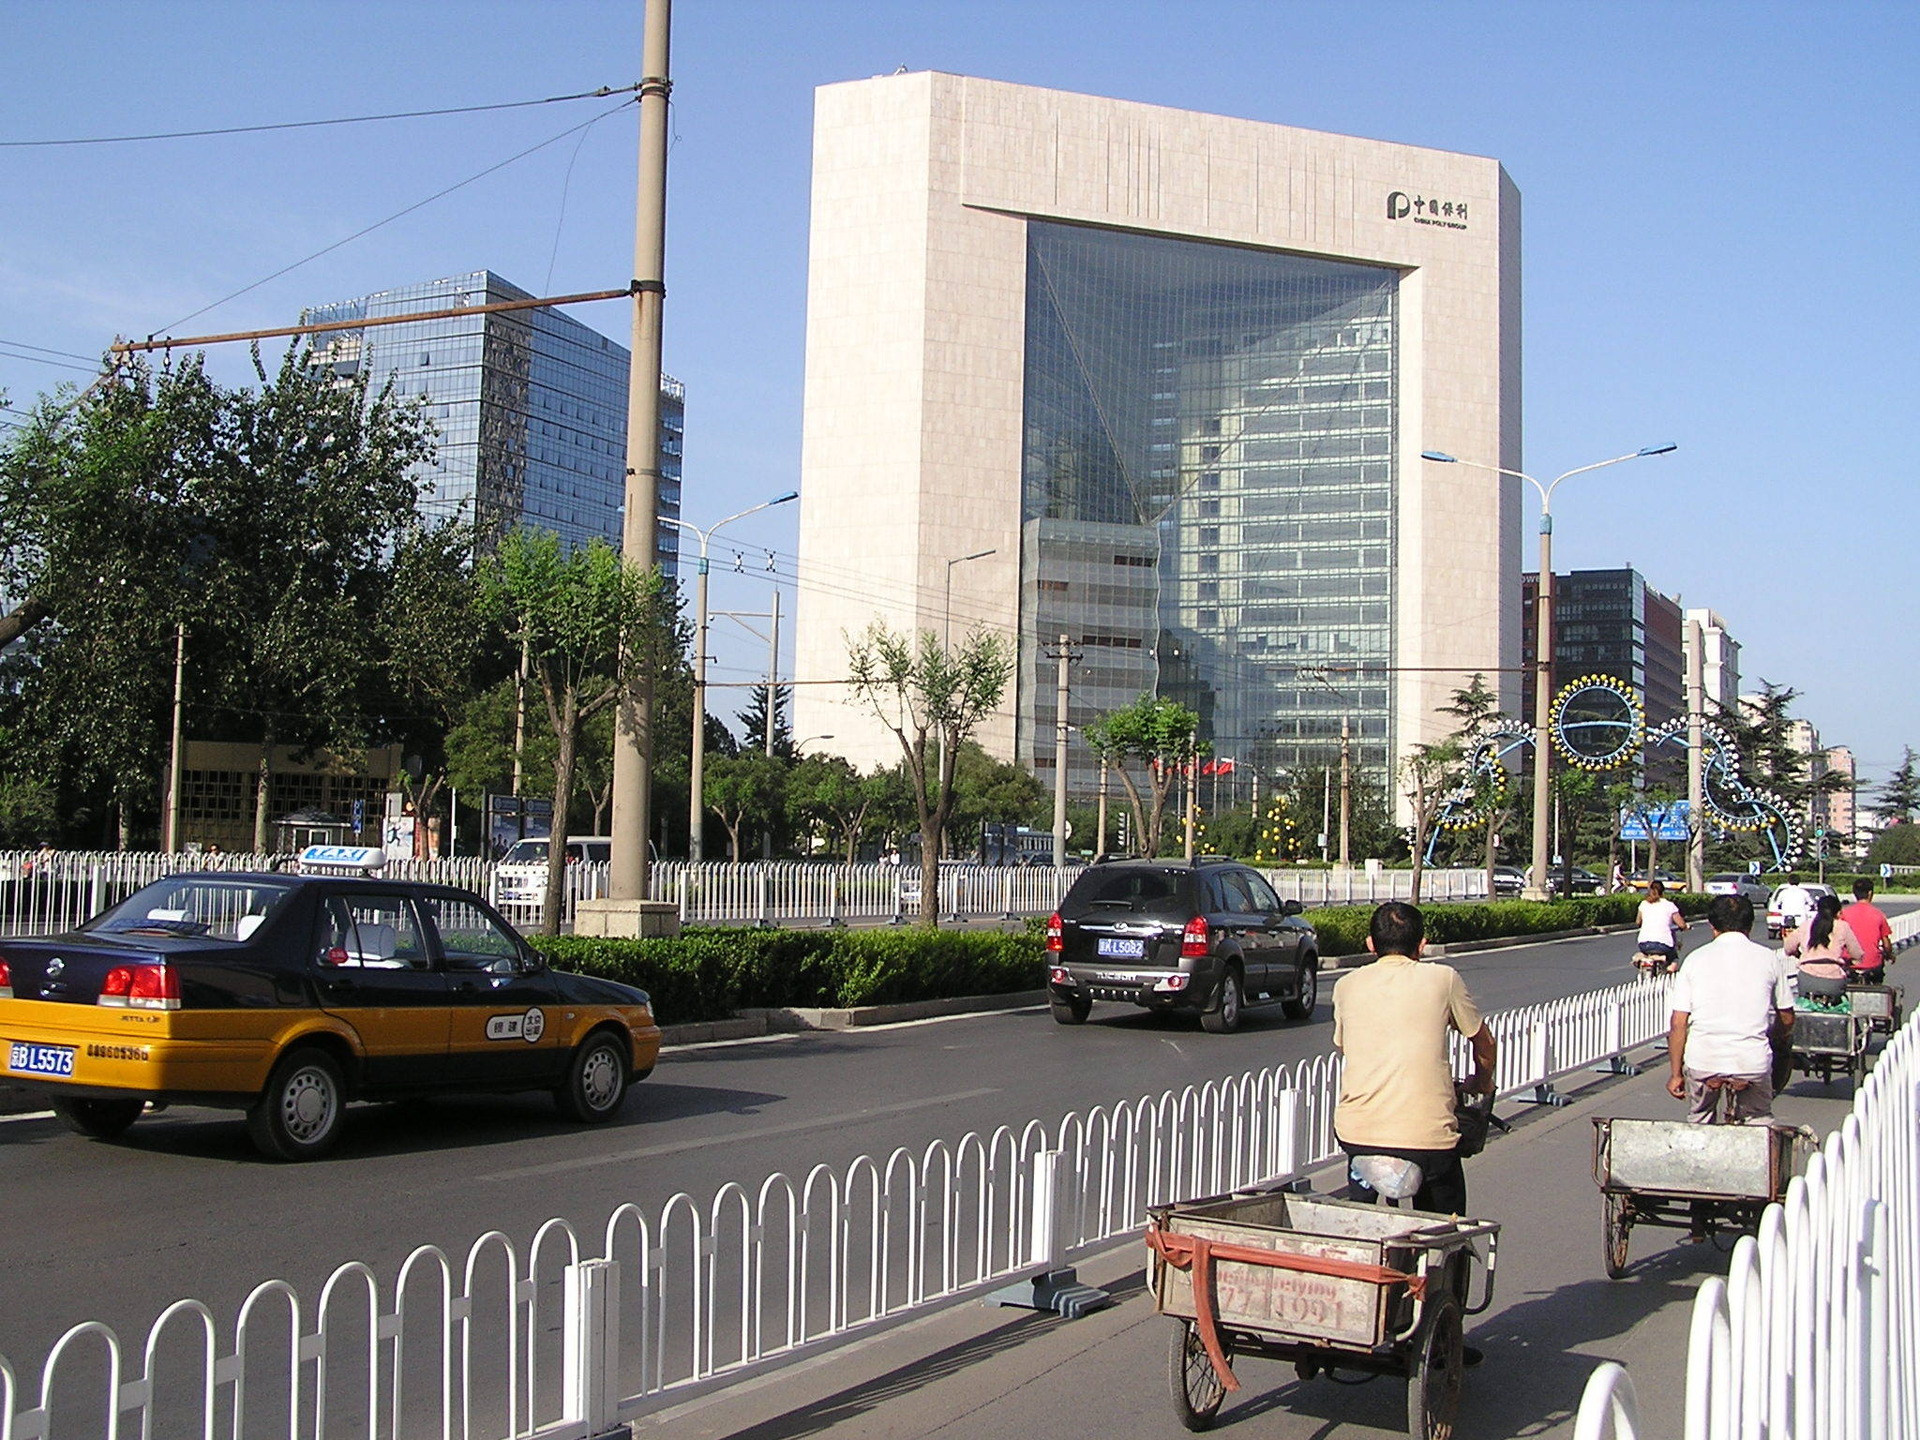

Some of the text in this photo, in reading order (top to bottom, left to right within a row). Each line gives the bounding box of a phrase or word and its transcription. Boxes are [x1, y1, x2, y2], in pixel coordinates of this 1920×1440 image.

[1413, 217, 1431, 226] CHINA
[1432, 220, 1446, 228] POLY
[309, 847, 367, 860] TAXI
